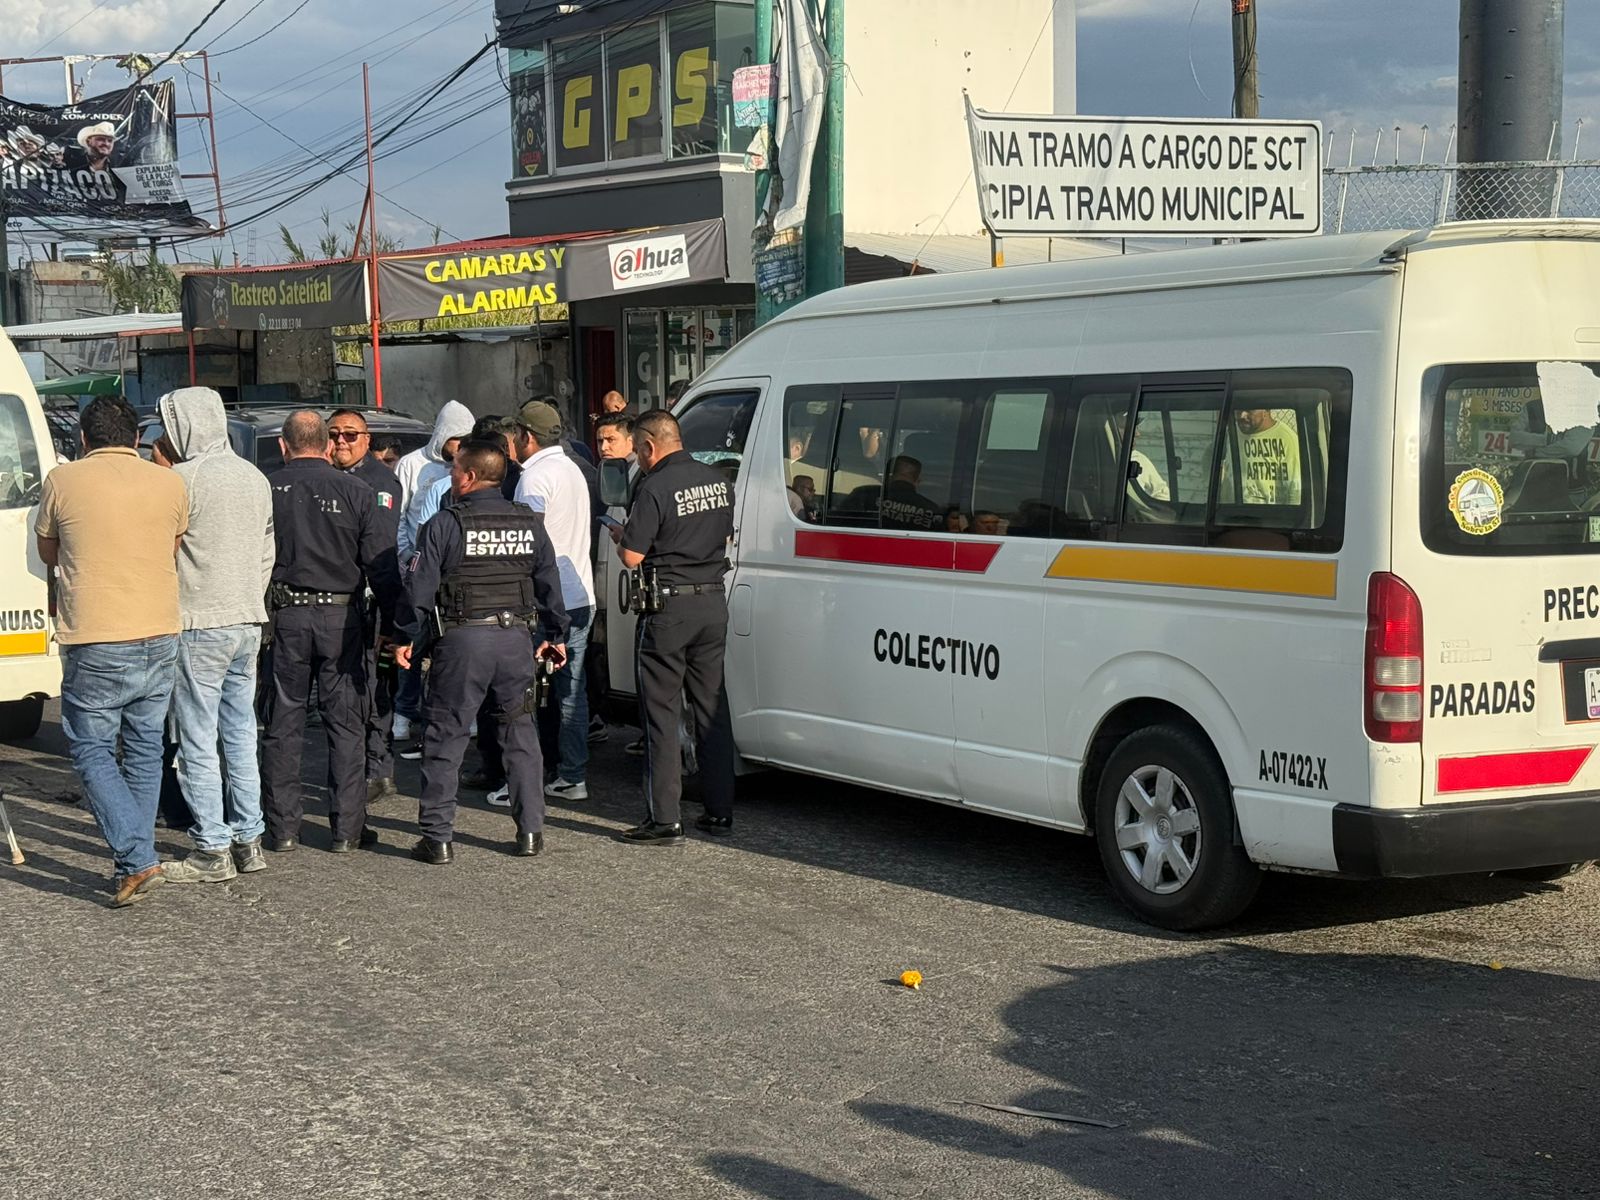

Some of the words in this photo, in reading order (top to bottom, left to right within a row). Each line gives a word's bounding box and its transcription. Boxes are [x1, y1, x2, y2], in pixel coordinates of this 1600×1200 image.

[562, 47, 710, 149] GPS
[1028, 132, 1113, 168] TRAMO
[1118, 134, 1136, 169] A
[1141, 134, 1222, 170] CARGO
[1229, 136, 1257, 170] DE
[1263, 137, 1307, 171] SCT
[1060, 185, 1155, 221] TRAMO
[1162, 186, 1304, 221] MUNICIPAL
[424, 249, 547, 284] CAMARAS
[550, 247, 566, 269] Y
[231, 282, 276, 306] Rastreo
[279, 275, 332, 306] Satelital
[437, 283, 558, 317] ALARMAS
[1491, 401, 1522, 413] MESES
[674, 482, 728, 504] CAMINOS
[677, 496, 729, 517] ESTATAL
[465, 542, 533, 556] ESTATAL
[466, 530, 534, 543] POLICIA
[1544, 585, 1600, 622] PREC
[874, 628, 1000, 680] COLECTIVO
[1430, 679, 1535, 718] PARADAS
[1259, 749, 1328, 790] A-07422-X
